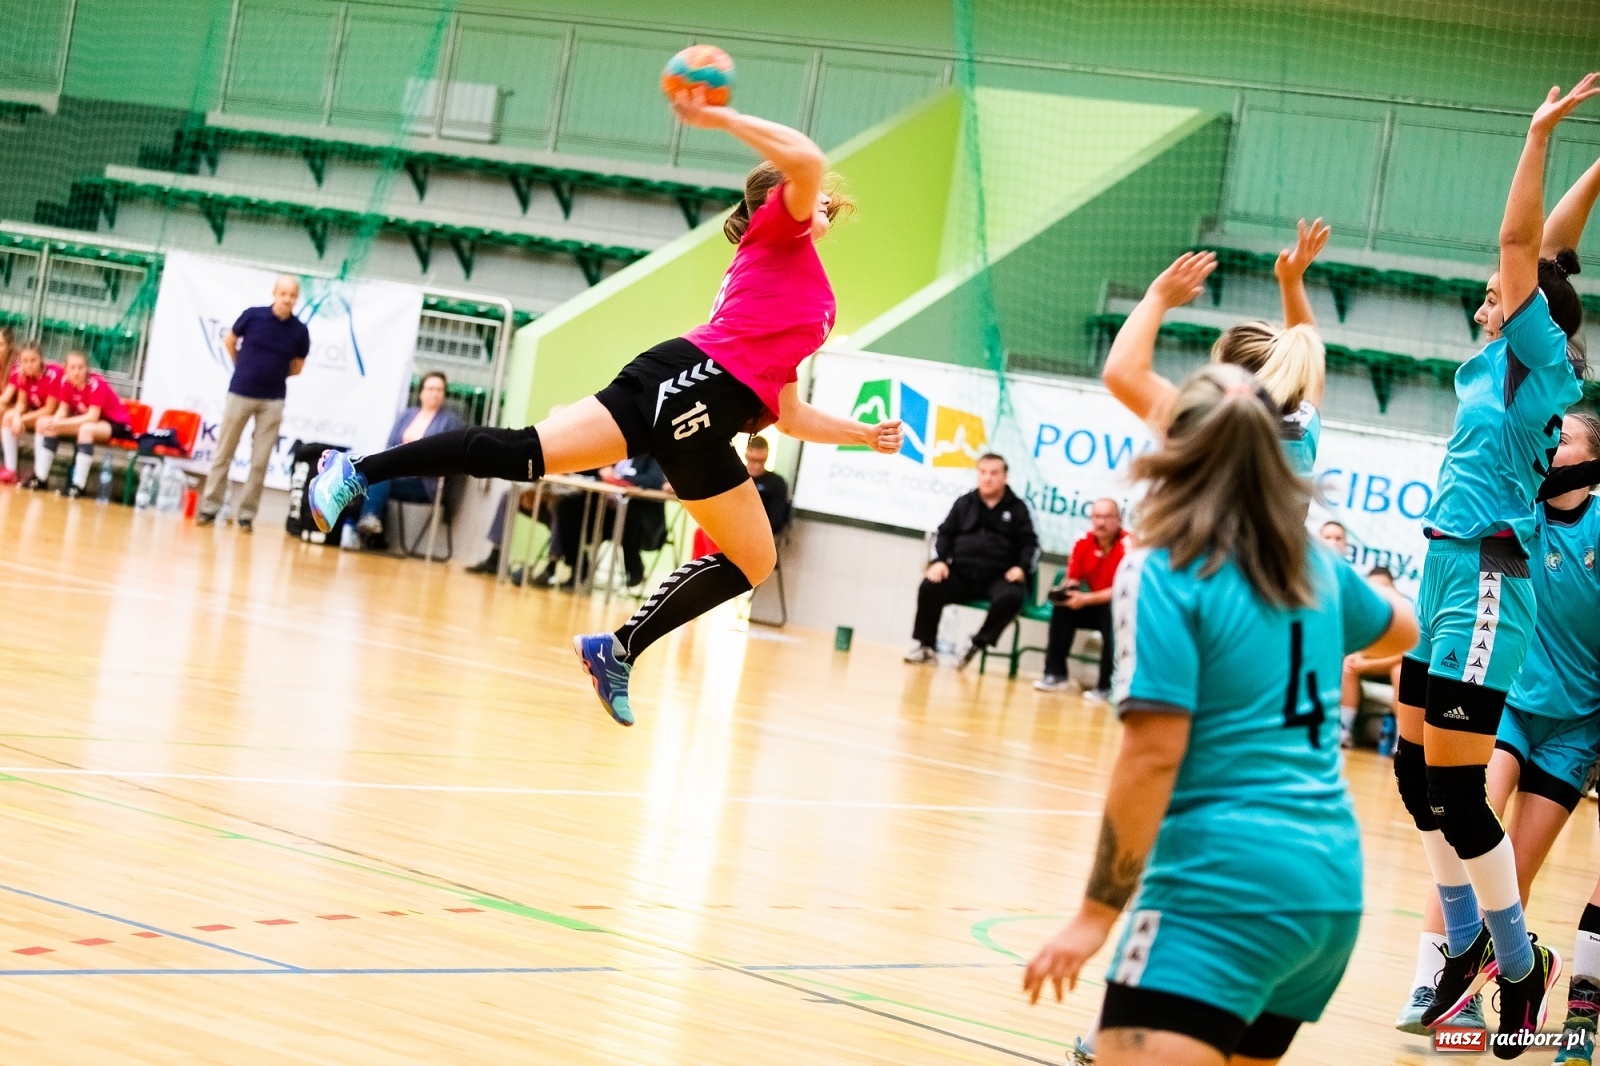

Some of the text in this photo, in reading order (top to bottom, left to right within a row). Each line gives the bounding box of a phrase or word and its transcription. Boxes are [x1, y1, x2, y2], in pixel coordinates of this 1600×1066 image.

[671, 400, 711, 441] 15
[1034, 423, 1433, 520] POW CIBO
[1346, 543, 1418, 581] amy.
[1441, 660, 1459, 670] SELECT
[1283, 621, 1324, 750] 4
[1443, 712, 1470, 720] adidas
